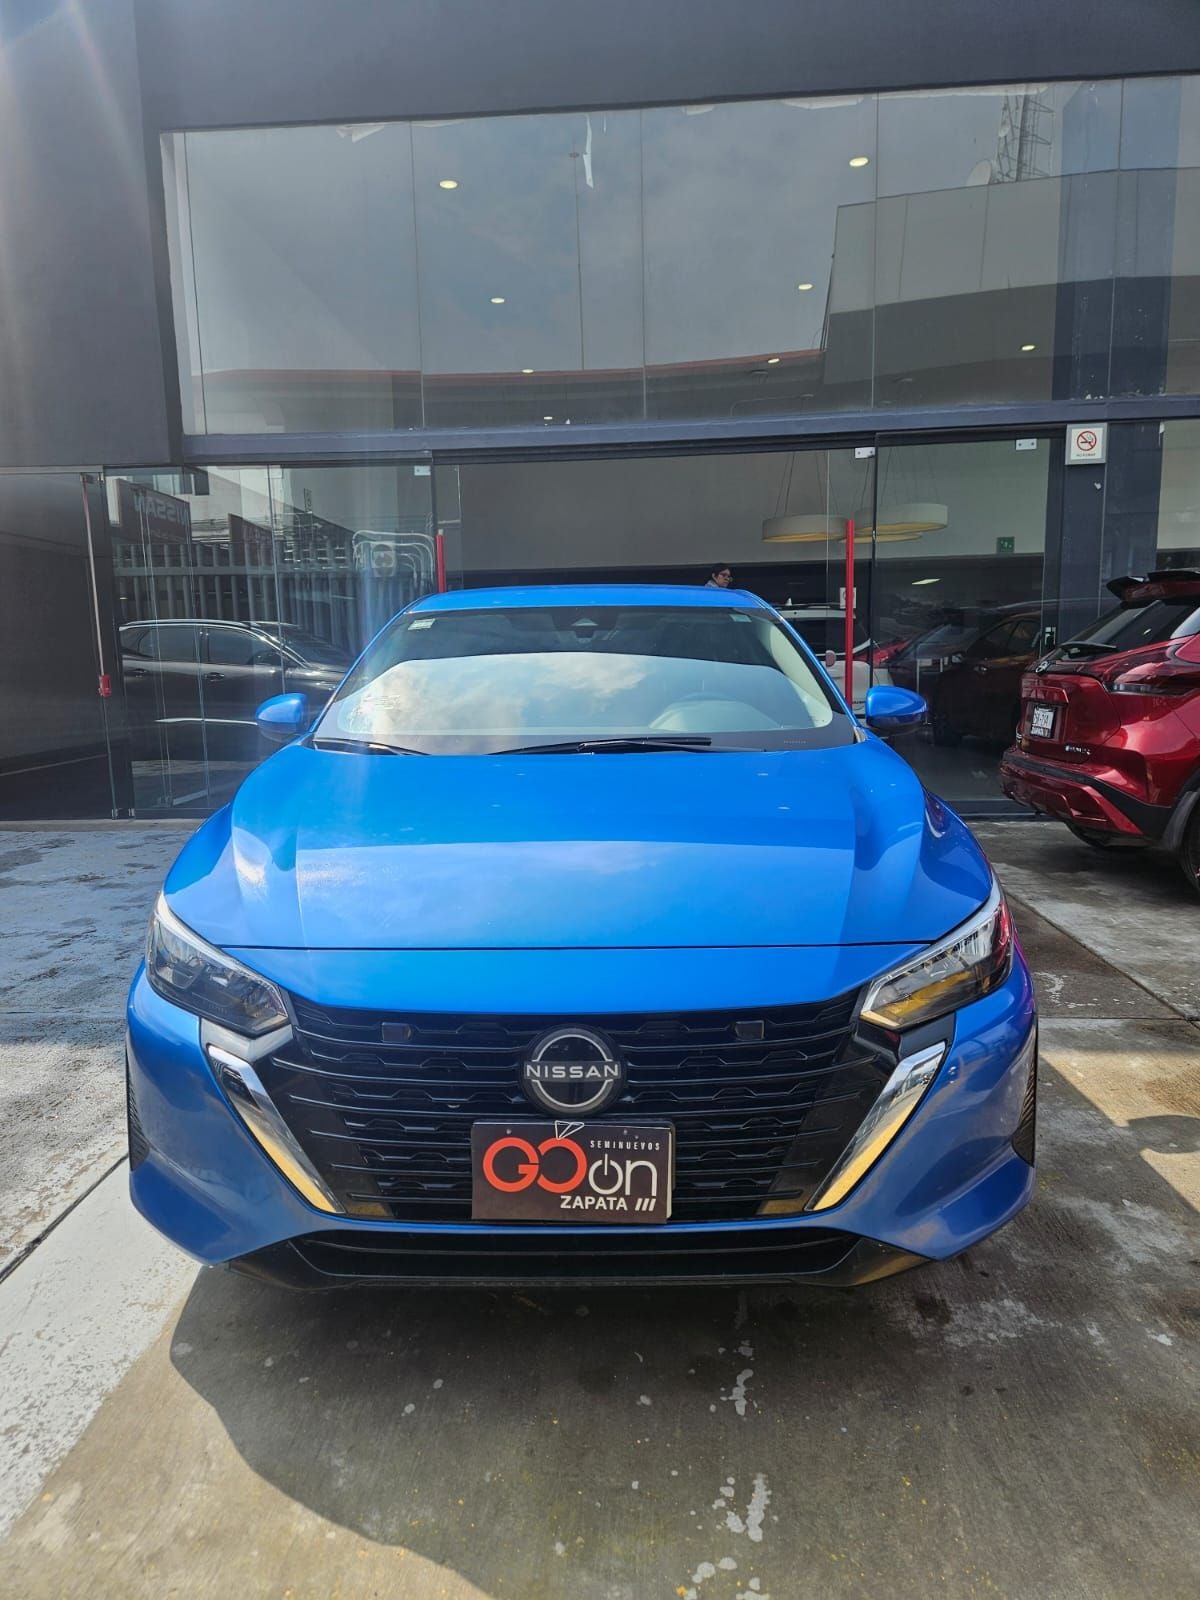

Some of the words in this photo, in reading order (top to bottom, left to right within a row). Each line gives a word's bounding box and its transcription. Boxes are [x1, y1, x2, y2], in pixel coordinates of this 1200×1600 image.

[526, 1064, 619, 1078] NISSAN
[590, 1140, 661, 1151] SEMINUEVOS
[560, 1195, 628, 1211] ZAPATA
